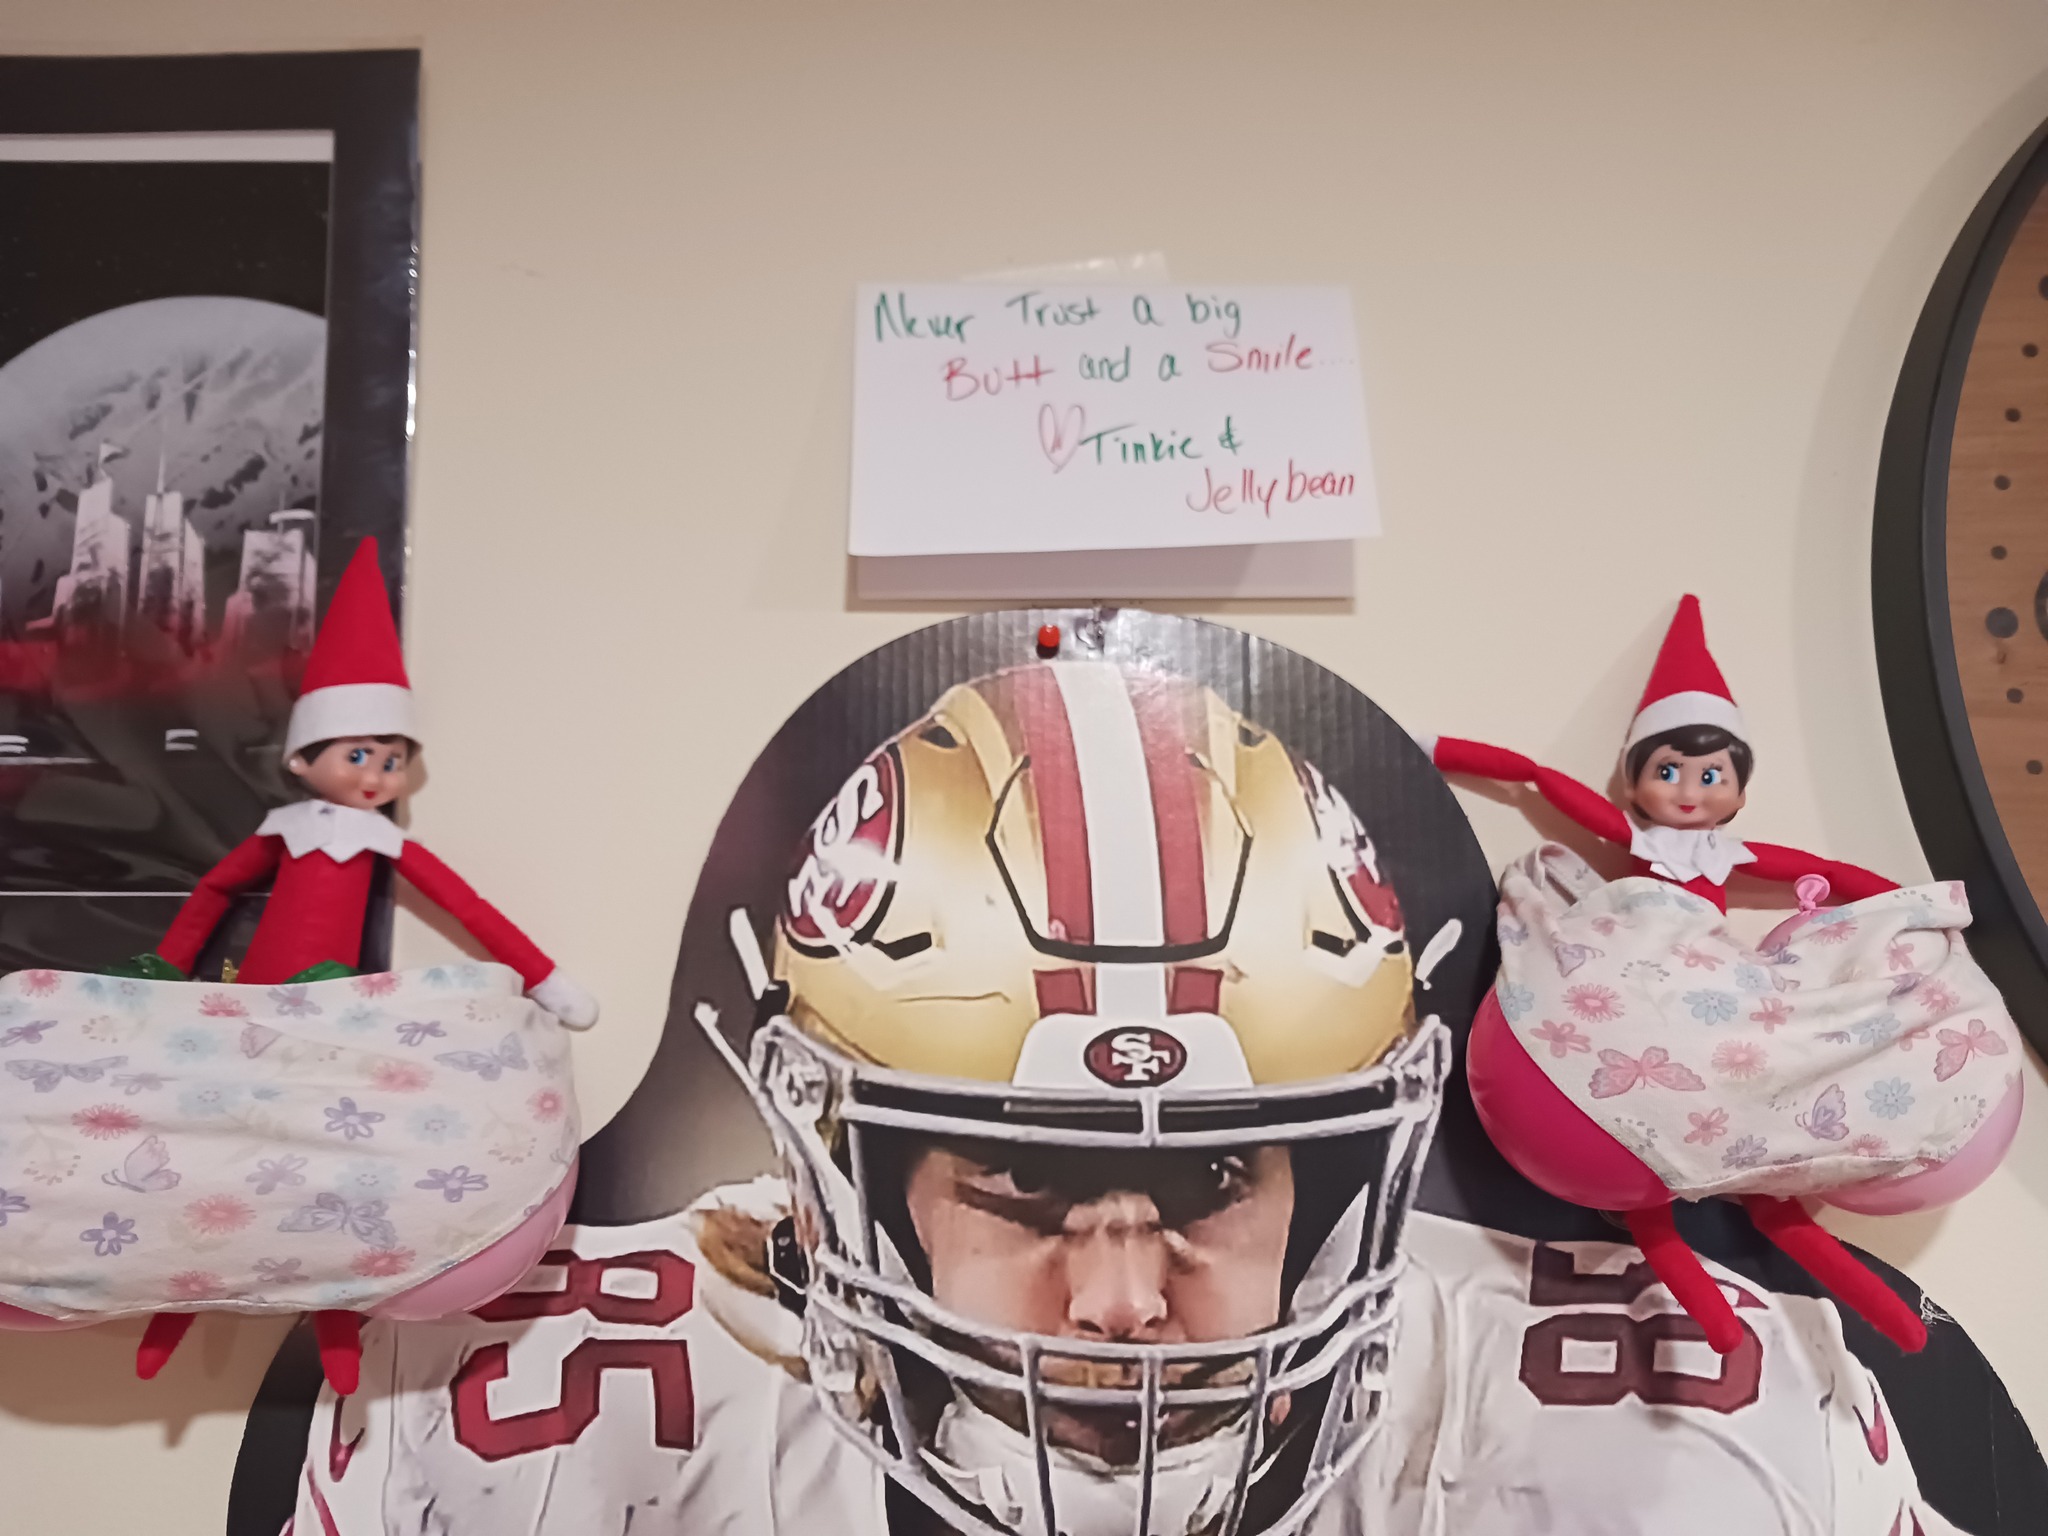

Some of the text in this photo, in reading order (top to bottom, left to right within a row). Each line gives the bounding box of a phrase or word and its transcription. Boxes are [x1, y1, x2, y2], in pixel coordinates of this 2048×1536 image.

[874, 291, 1241, 342] Never Trust a big
[943, 354, 1055, 402] Butt
[1078, 346, 1131, 383] and
[1158, 353, 1183, 382] a
[1078, 423, 1202, 464] Tinkie
[450, 1249, 695, 1462] 85
